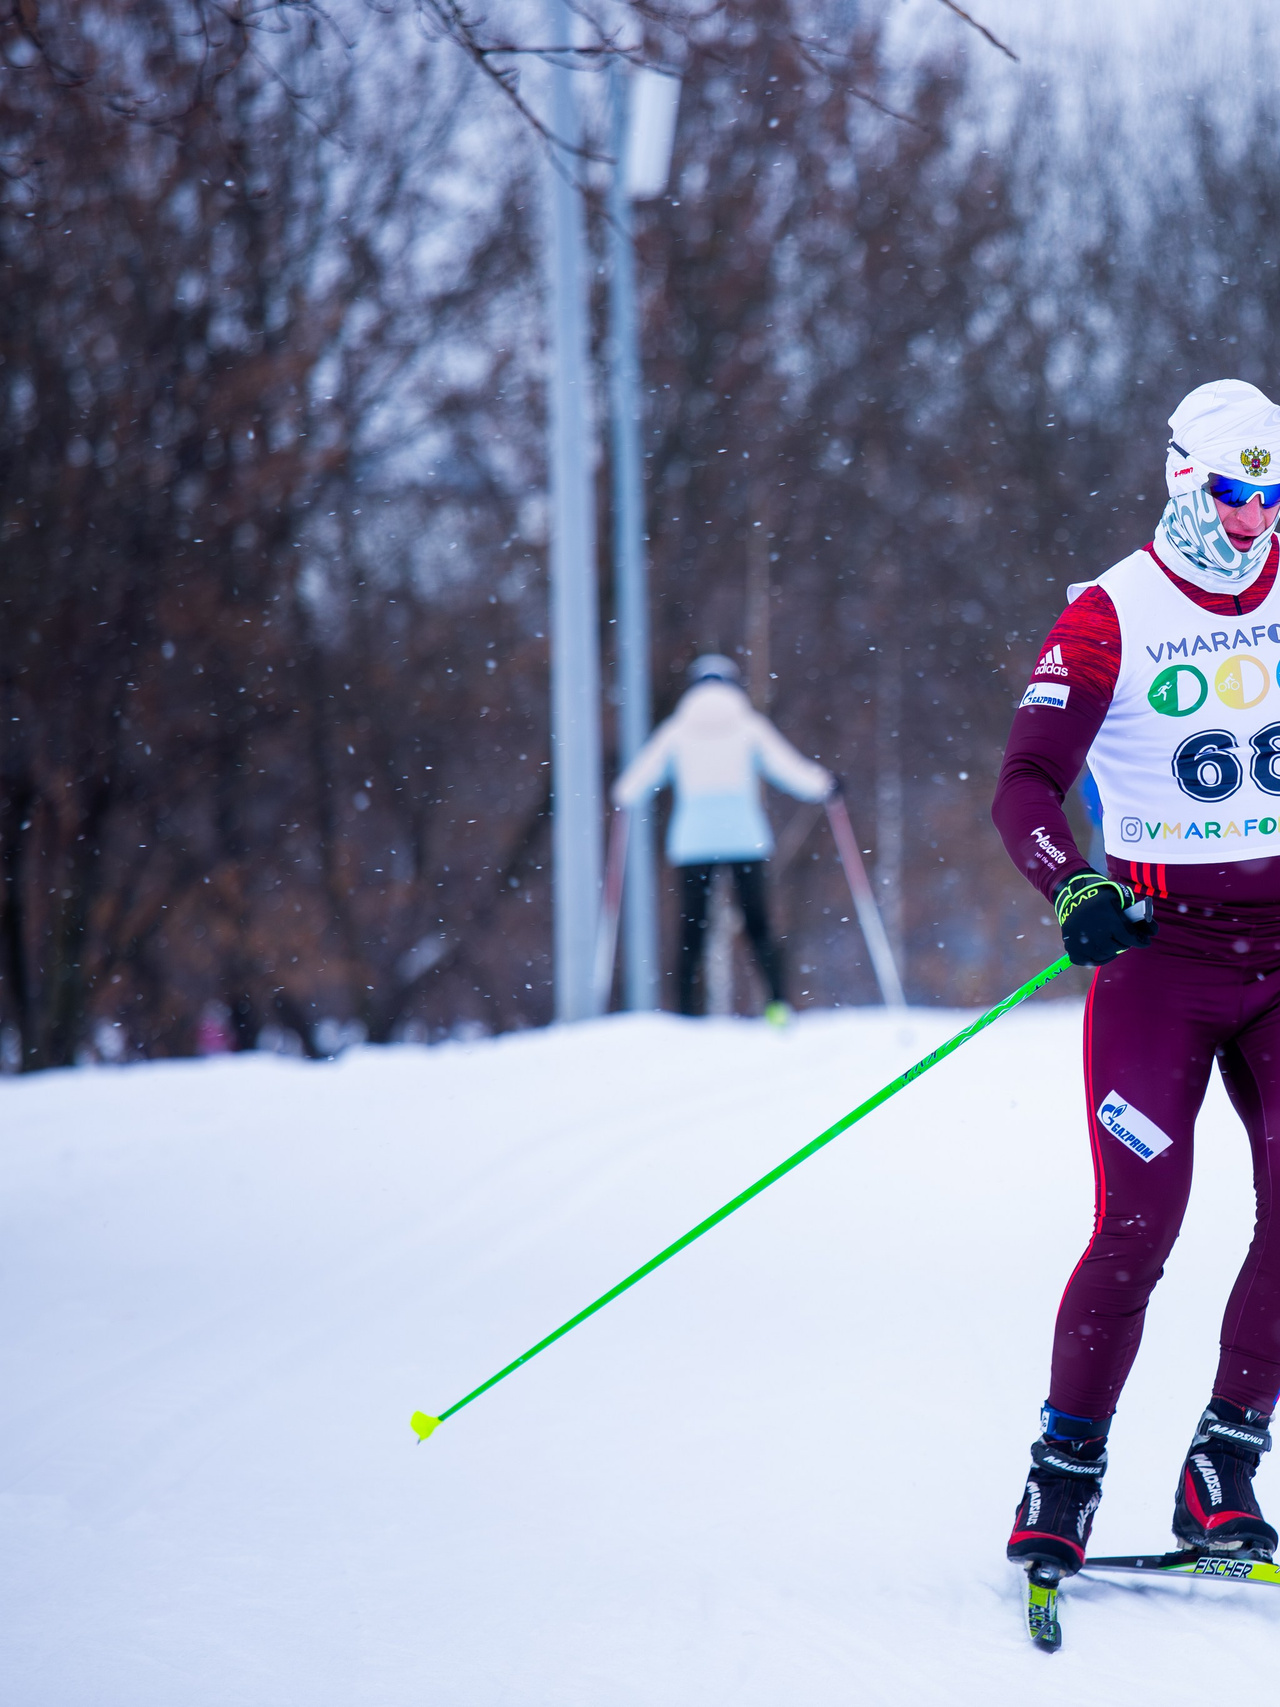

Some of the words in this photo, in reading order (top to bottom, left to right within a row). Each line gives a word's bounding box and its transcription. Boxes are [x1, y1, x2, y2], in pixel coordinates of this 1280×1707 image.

[1034, 663, 1069, 677] adidas
[1031, 696, 1065, 707] GAZPROM
[1111, 1122, 1155, 1159] GAZPROM
[1208, 1422, 1264, 1446] MADSHUS
[1042, 1455, 1102, 1474] MADSHUS
[1190, 1453, 1223, 1507] MADSHUS
[1026, 1481, 1042, 1527] MADSHUS
[1193, 1556, 1254, 1579] FISCHER
